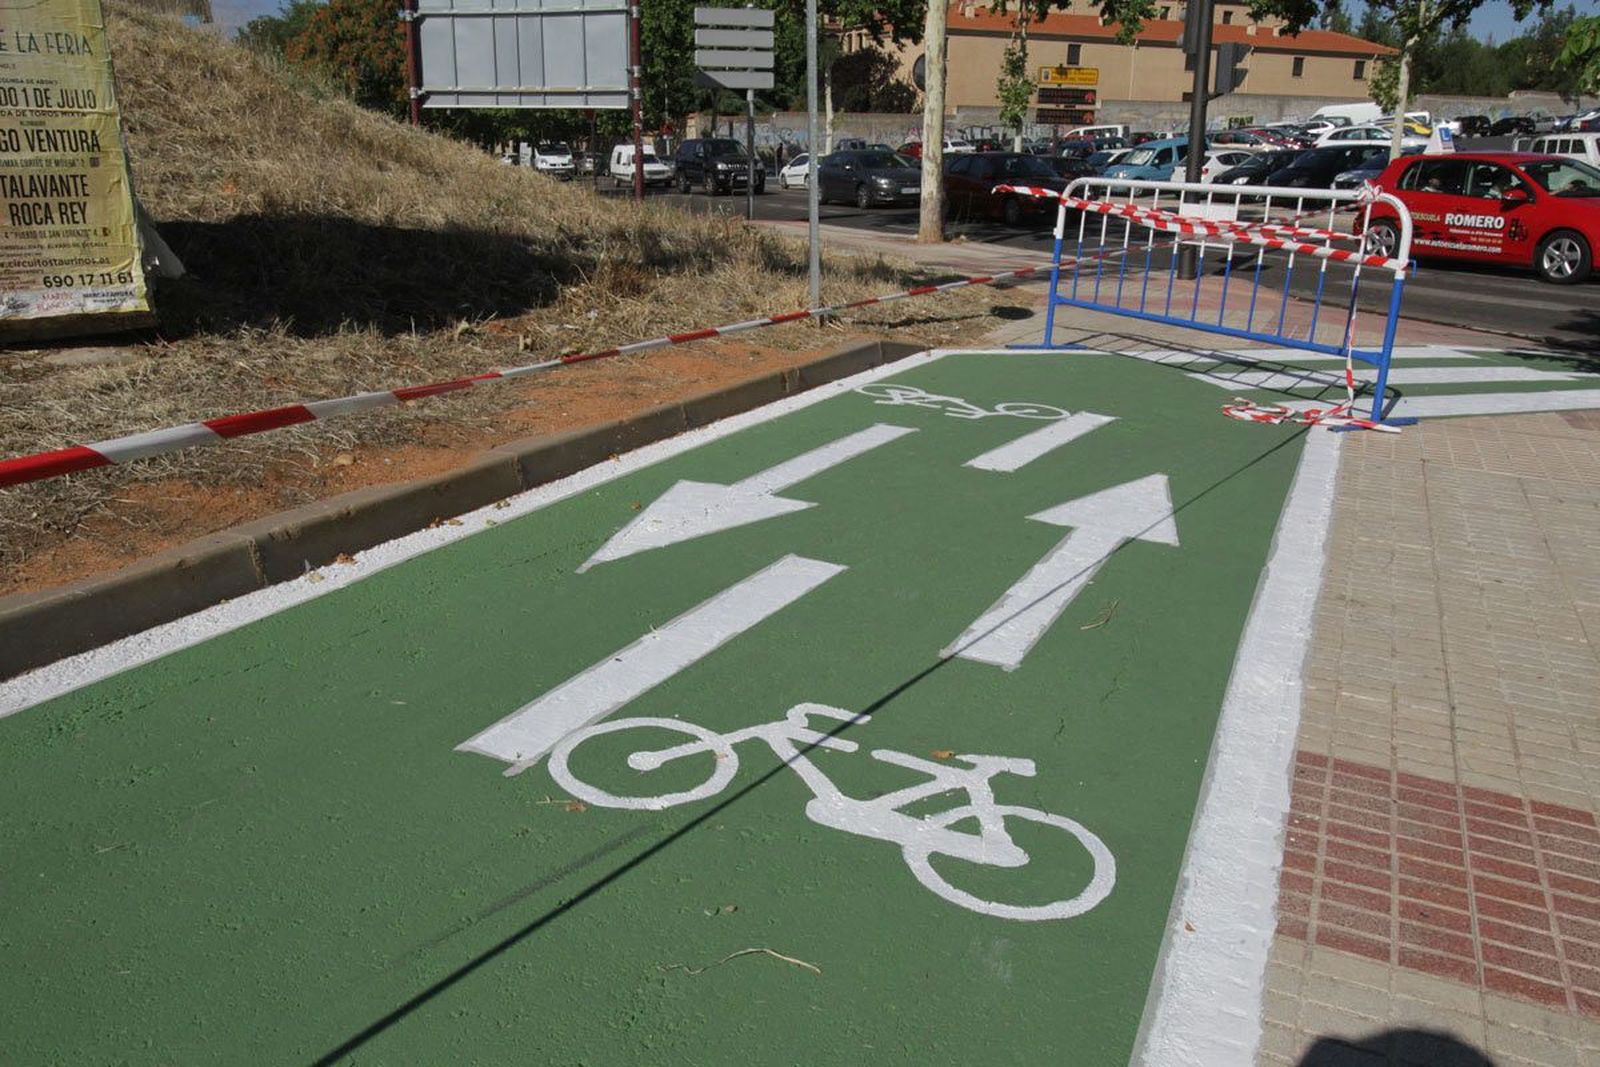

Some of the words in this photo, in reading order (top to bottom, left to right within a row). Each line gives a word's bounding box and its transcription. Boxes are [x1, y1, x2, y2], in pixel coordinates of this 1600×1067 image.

[15, 31, 41, 54] LA
[44, 32, 94, 56] FERIA
[21, 87, 30, 108] 1
[33, 87, 53, 109] DE
[57, 87, 97, 110] JULIO
[24, 129, 100, 153] VENTURA
[0, 174, 90, 199] TALAVANTE
[9, 202, 55, 227] ROCA
[58, 201, 87, 225] REY
[1444, 212, 1505, 229] ROMERO
[43, 275, 74, 288] 690
[80, 273, 94, 286] 17
[100, 272, 113, 285] 11
[117, 271, 134, 284] 61
